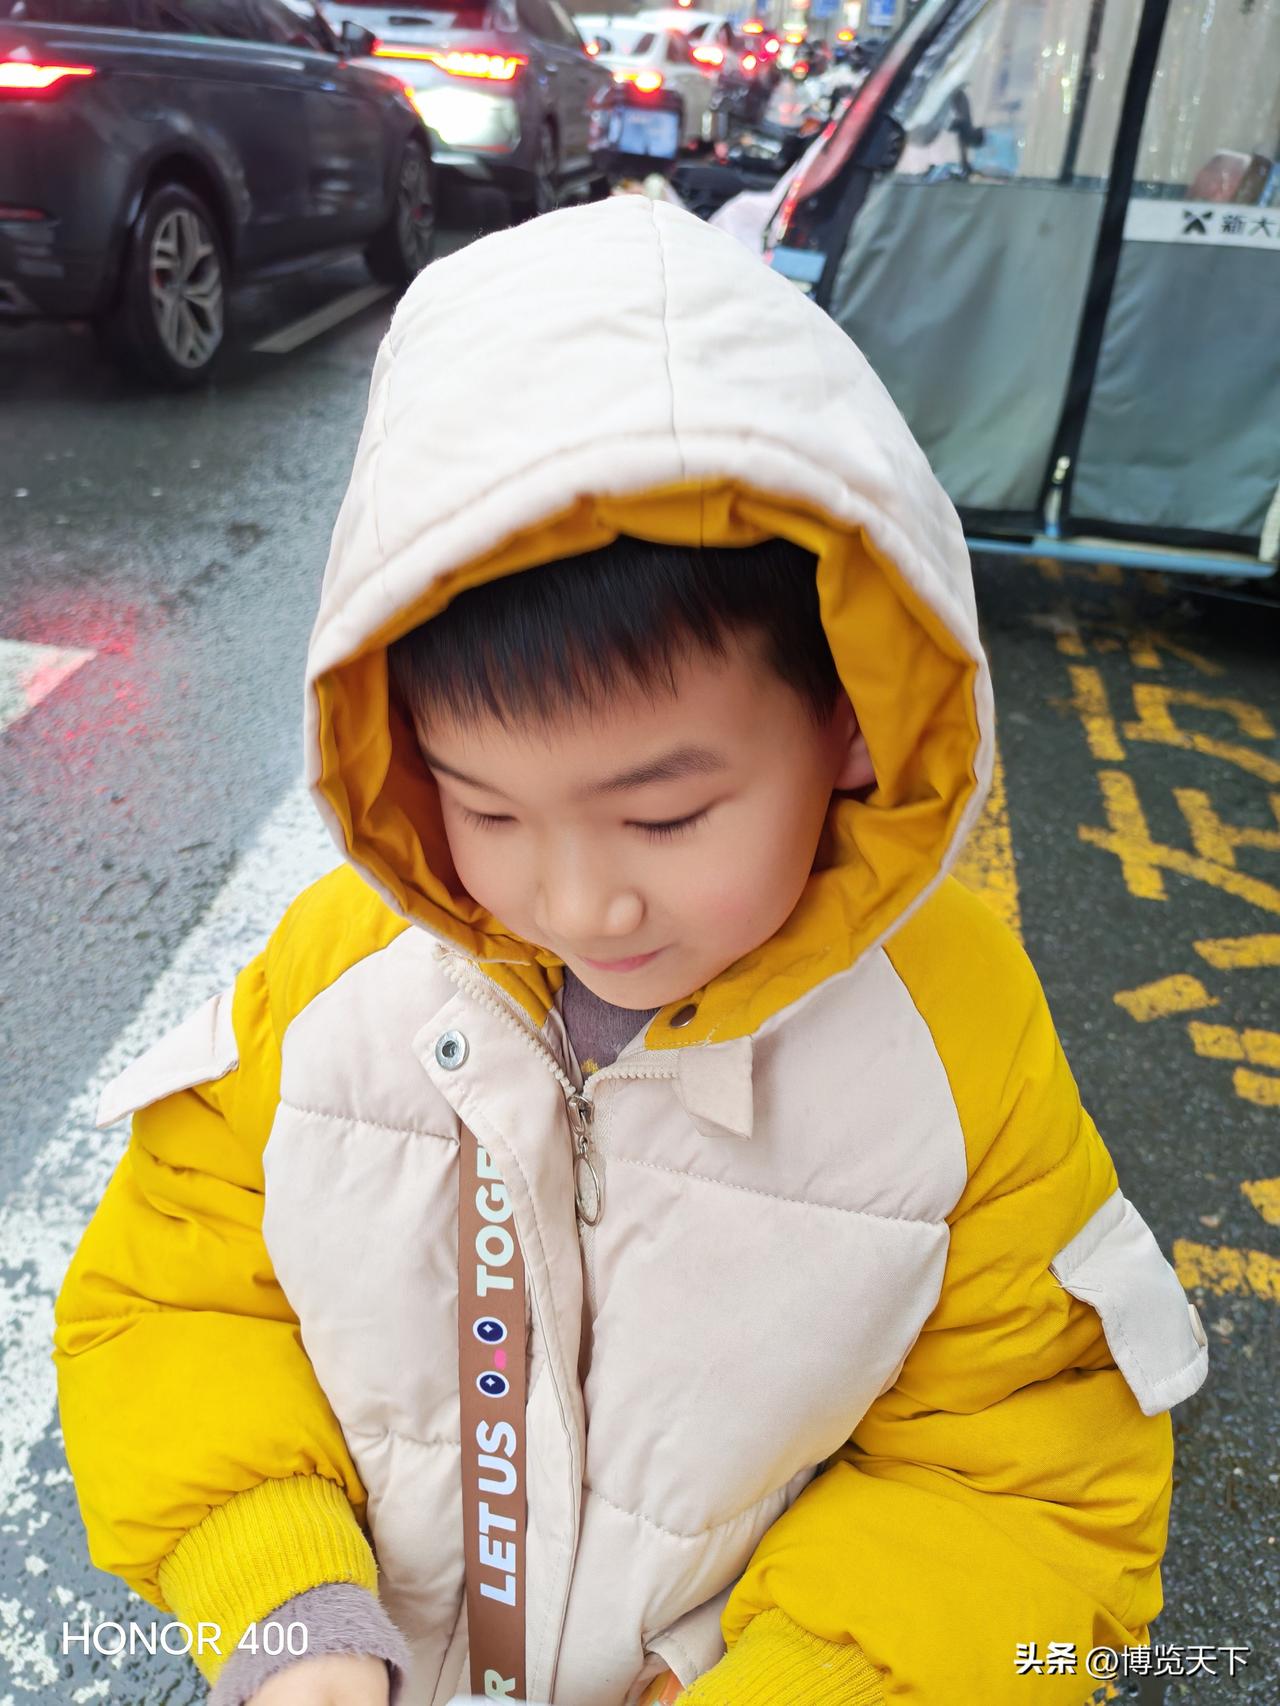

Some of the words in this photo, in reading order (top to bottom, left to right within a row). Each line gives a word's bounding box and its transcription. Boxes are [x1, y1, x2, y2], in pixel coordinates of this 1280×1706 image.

[1220, 213, 1280, 240] 新大
[476, 1420, 517, 1496] US
[479, 1501, 516, 1607] LET
